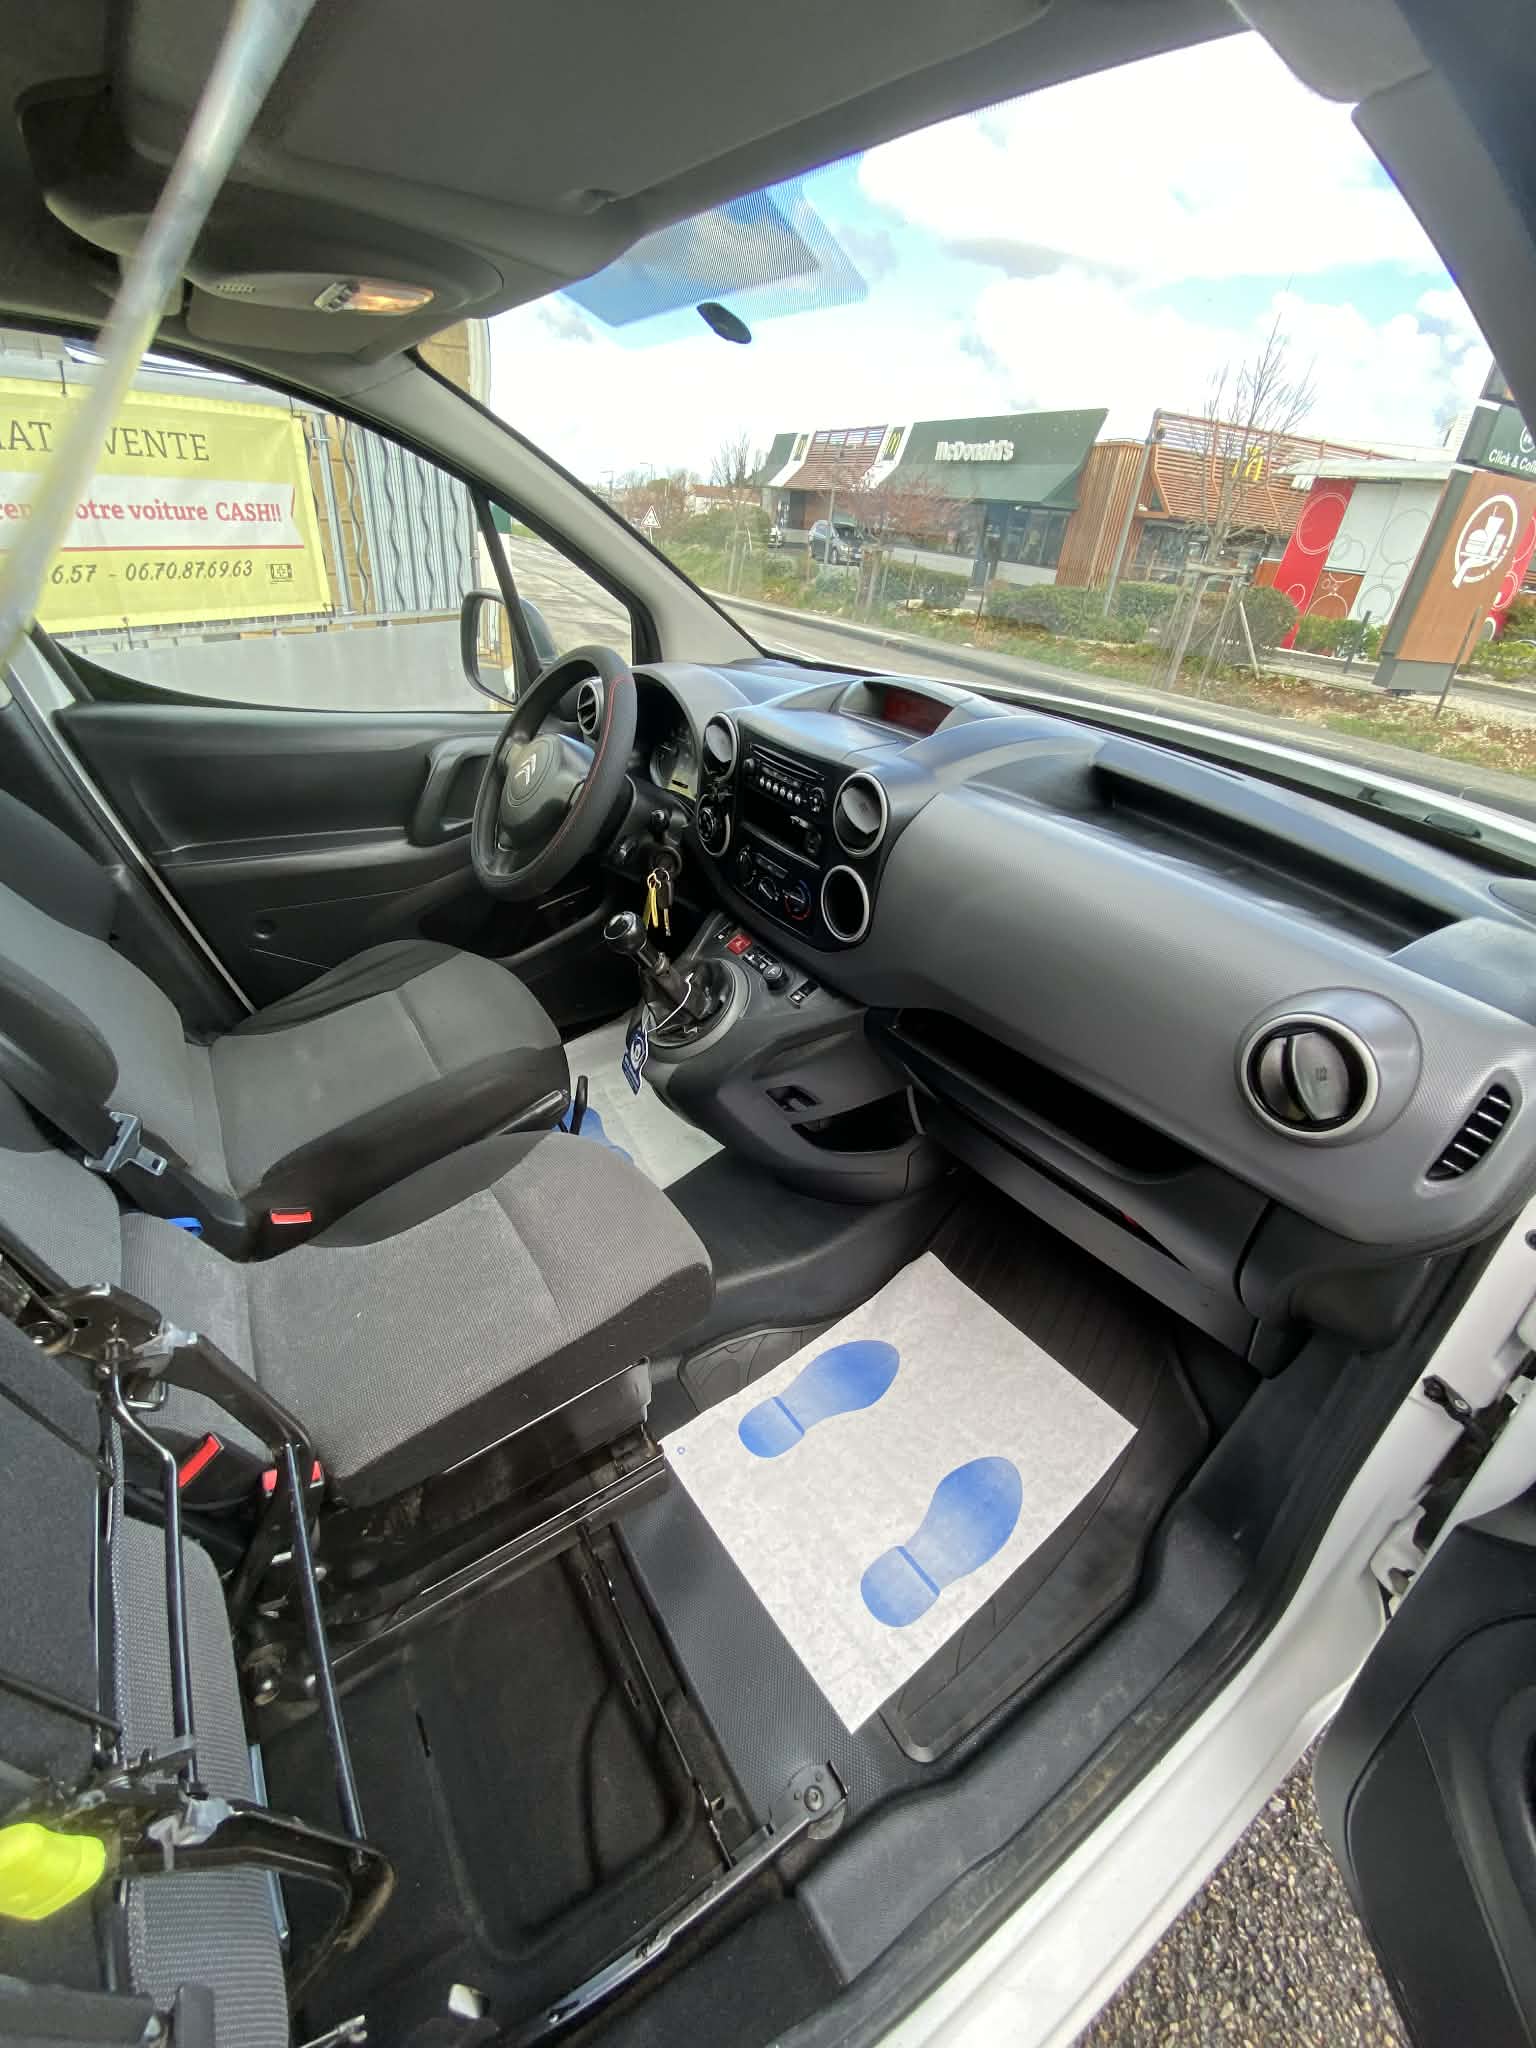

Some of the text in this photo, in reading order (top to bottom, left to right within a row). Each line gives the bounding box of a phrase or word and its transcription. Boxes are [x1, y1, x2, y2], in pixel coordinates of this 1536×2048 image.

[0, 420, 209, 461] AT VENTE
[935, 439, 1014, 461] McDonald's
[1488, 448, 1511, 466] Click
[1520, 457, 1536, 474] Coll
[74, 498, 125, 519] otre
[128, 498, 209, 520] voiture
[215, 501, 282, 522] CASH!!
[51, 564, 97, 585] 6.57
